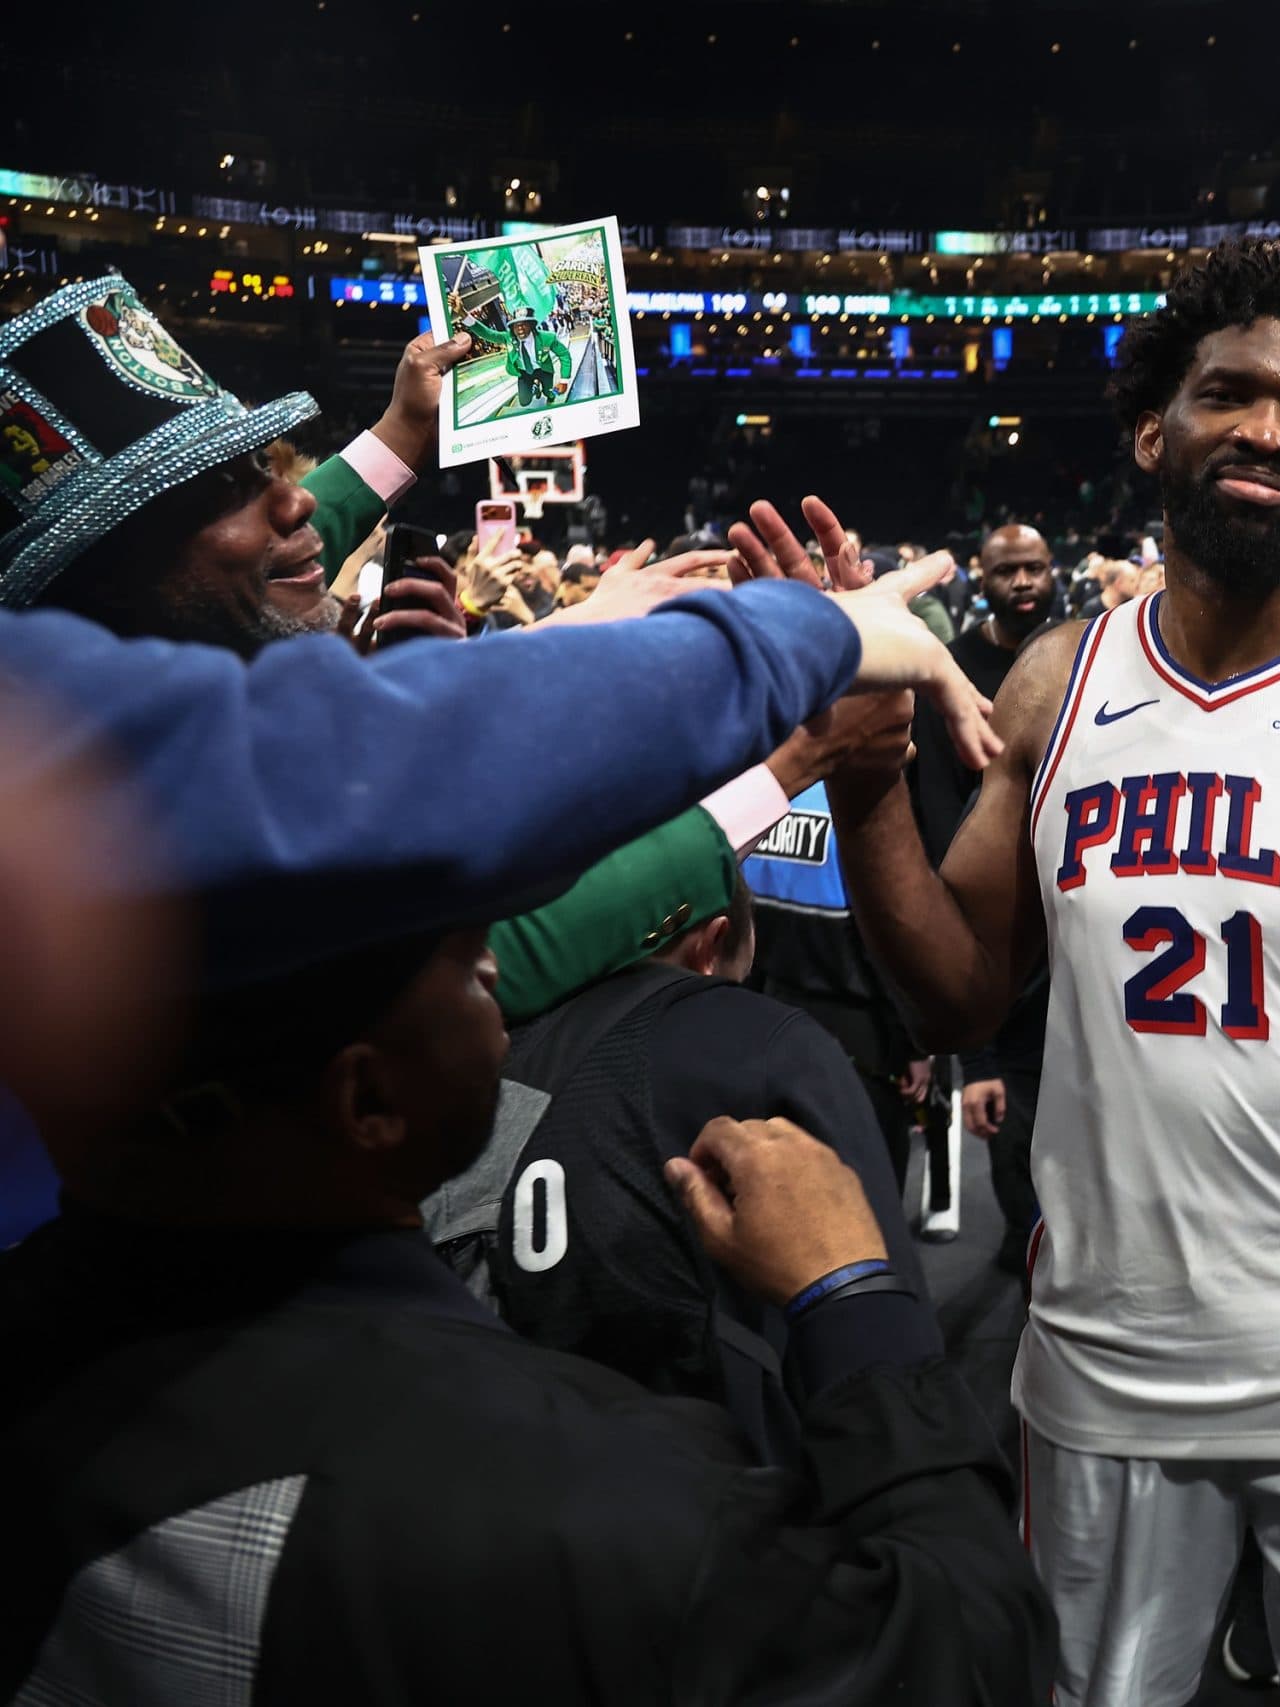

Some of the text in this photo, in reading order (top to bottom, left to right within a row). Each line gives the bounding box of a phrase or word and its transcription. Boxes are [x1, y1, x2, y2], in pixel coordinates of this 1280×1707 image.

[552, 259, 599, 275] GARDEN
[712, 294, 746, 312] 109
[109, 338, 185, 393] BOSTON
[39, 450, 82, 487] MARLEY
[1122, 906, 1269, 1041] 21
[513, 1158, 568, 1272] 0
